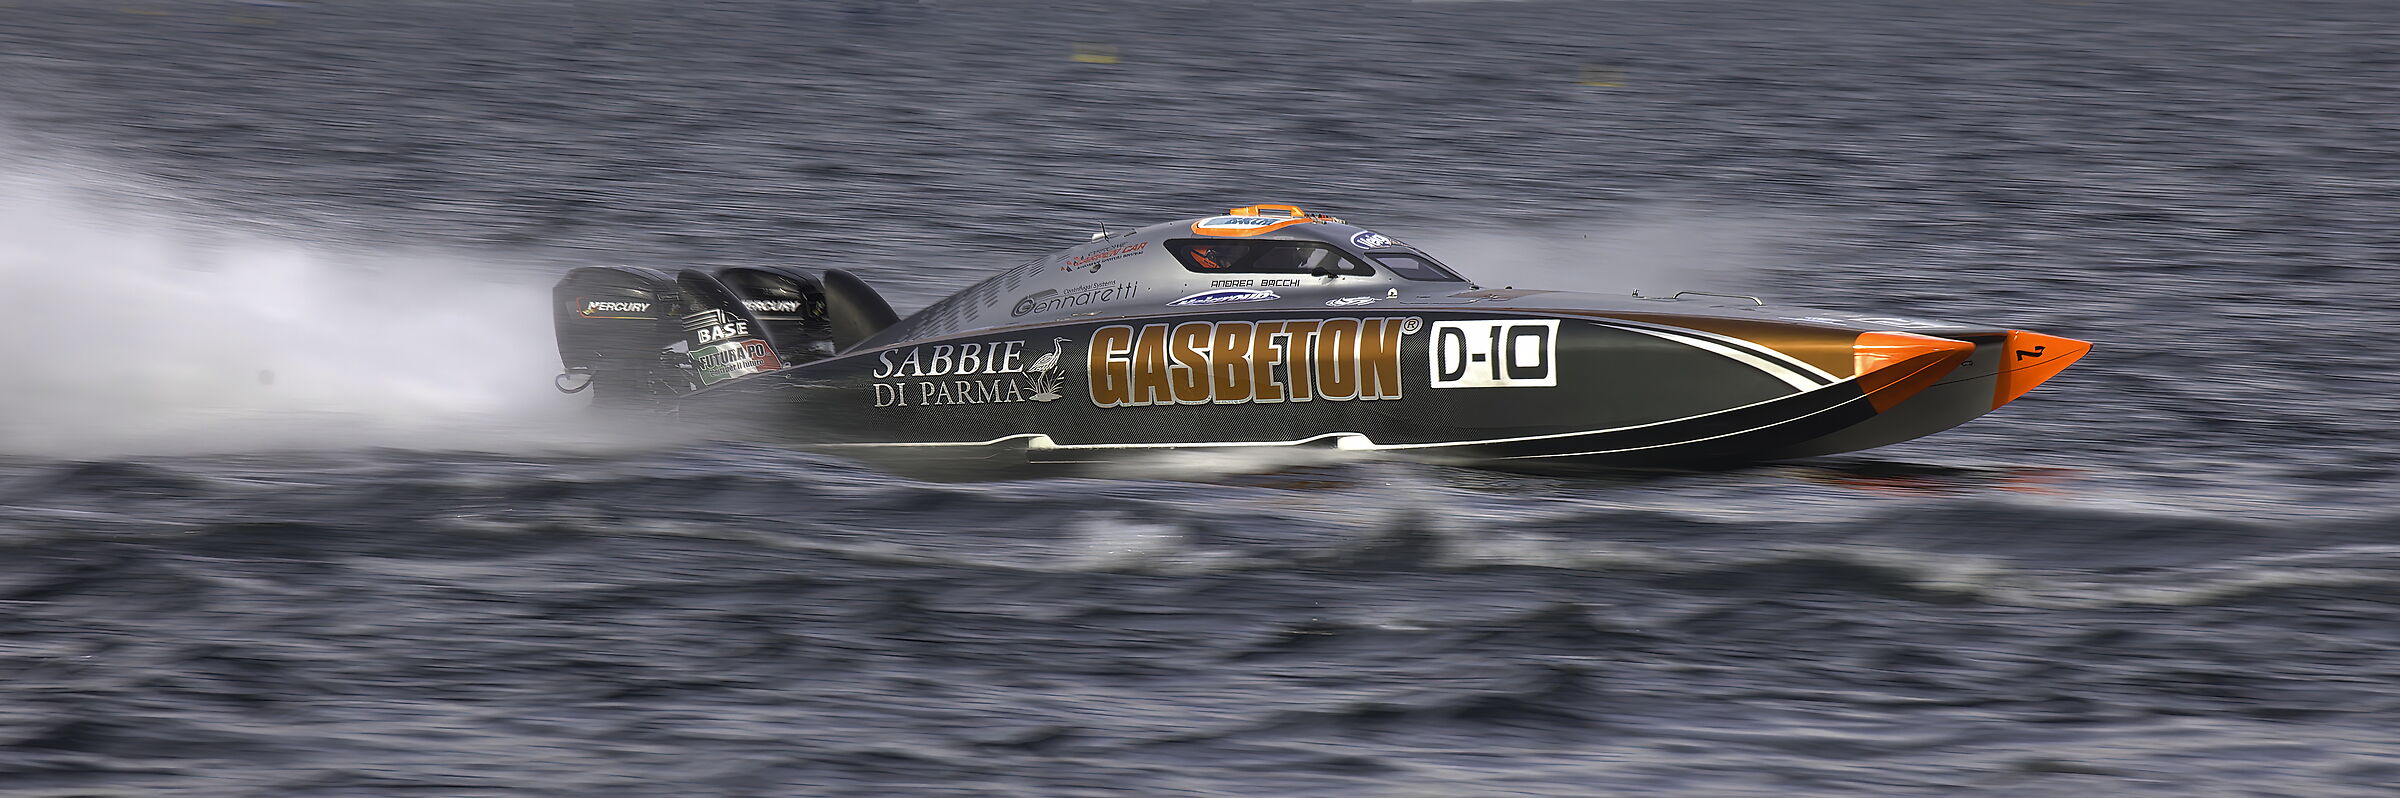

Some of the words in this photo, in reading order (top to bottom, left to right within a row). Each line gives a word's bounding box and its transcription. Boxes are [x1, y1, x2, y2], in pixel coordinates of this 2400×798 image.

[1092, 280, 1117, 290] Systems
[1210, 279, 1254, 288] ANDREA
[1260, 279, 1301, 287] BACCHI
[587, 301, 651, 313] MERCURY
[697, 322, 749, 344] BASE
[699, 346, 747, 371] FUTURA
[746, 344, 766, 359] PO
[873, 340, 1026, 379] SABBIE
[1088, 316, 1404, 407] GASBETON
[1438, 324, 1549, 382] D-10
[873, 382, 908, 408] DI
[919, 379, 1026, 406] PARMA
